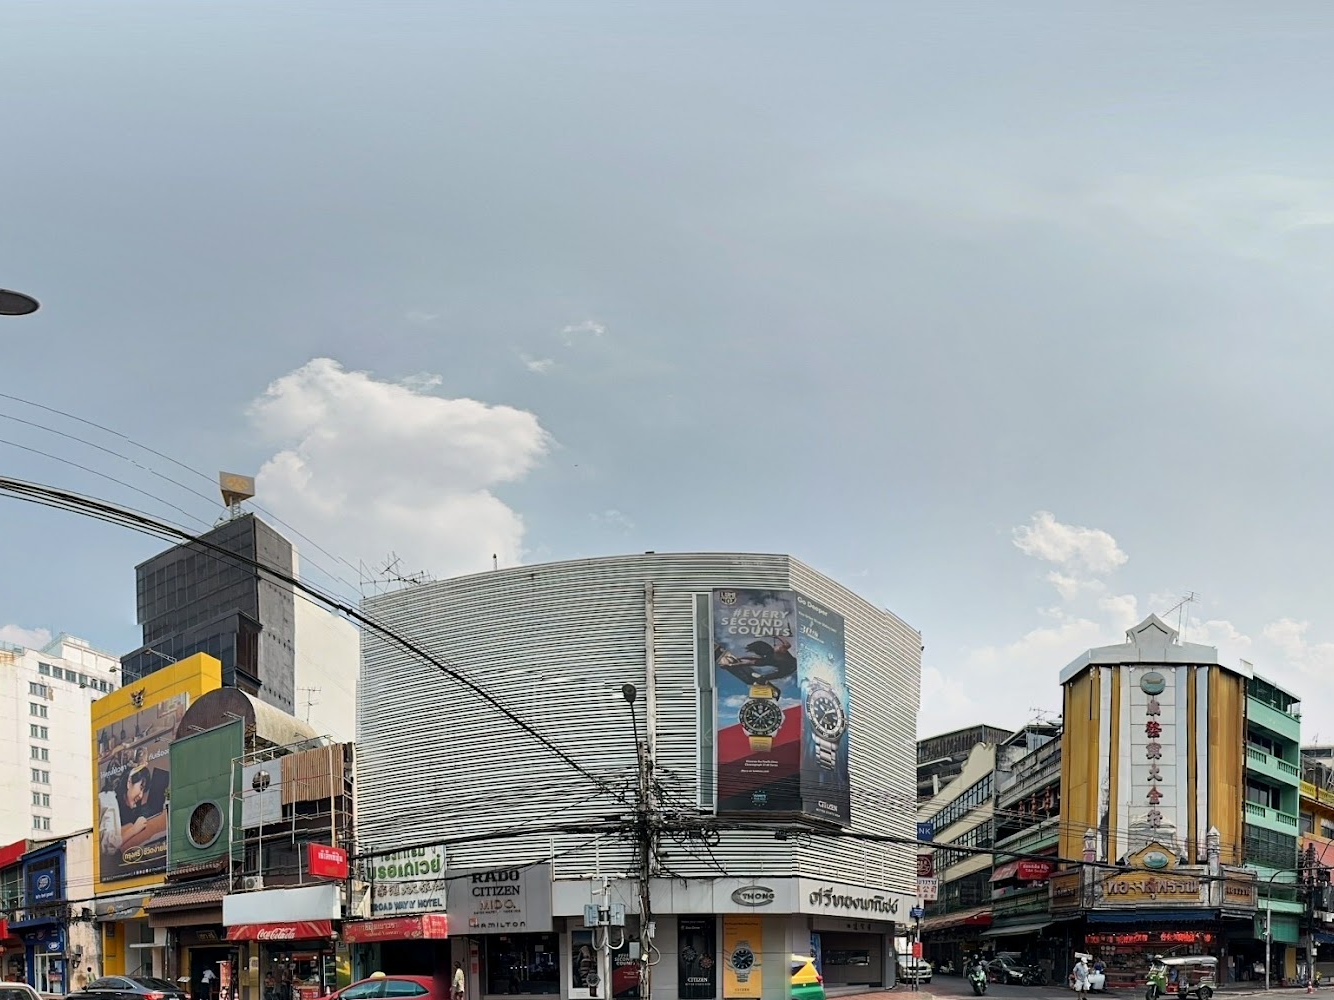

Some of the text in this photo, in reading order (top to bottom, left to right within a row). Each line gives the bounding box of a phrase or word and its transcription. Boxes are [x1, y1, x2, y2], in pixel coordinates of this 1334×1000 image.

[733, 609, 789, 619] #EVERY
[721, 617, 783, 628] SECOND
[728, 625, 791, 637] COUNTS
[471, 869, 520, 883] RADO
[472, 885, 520, 897] CITIZEN
[418, 898, 442, 908] HOTEL
